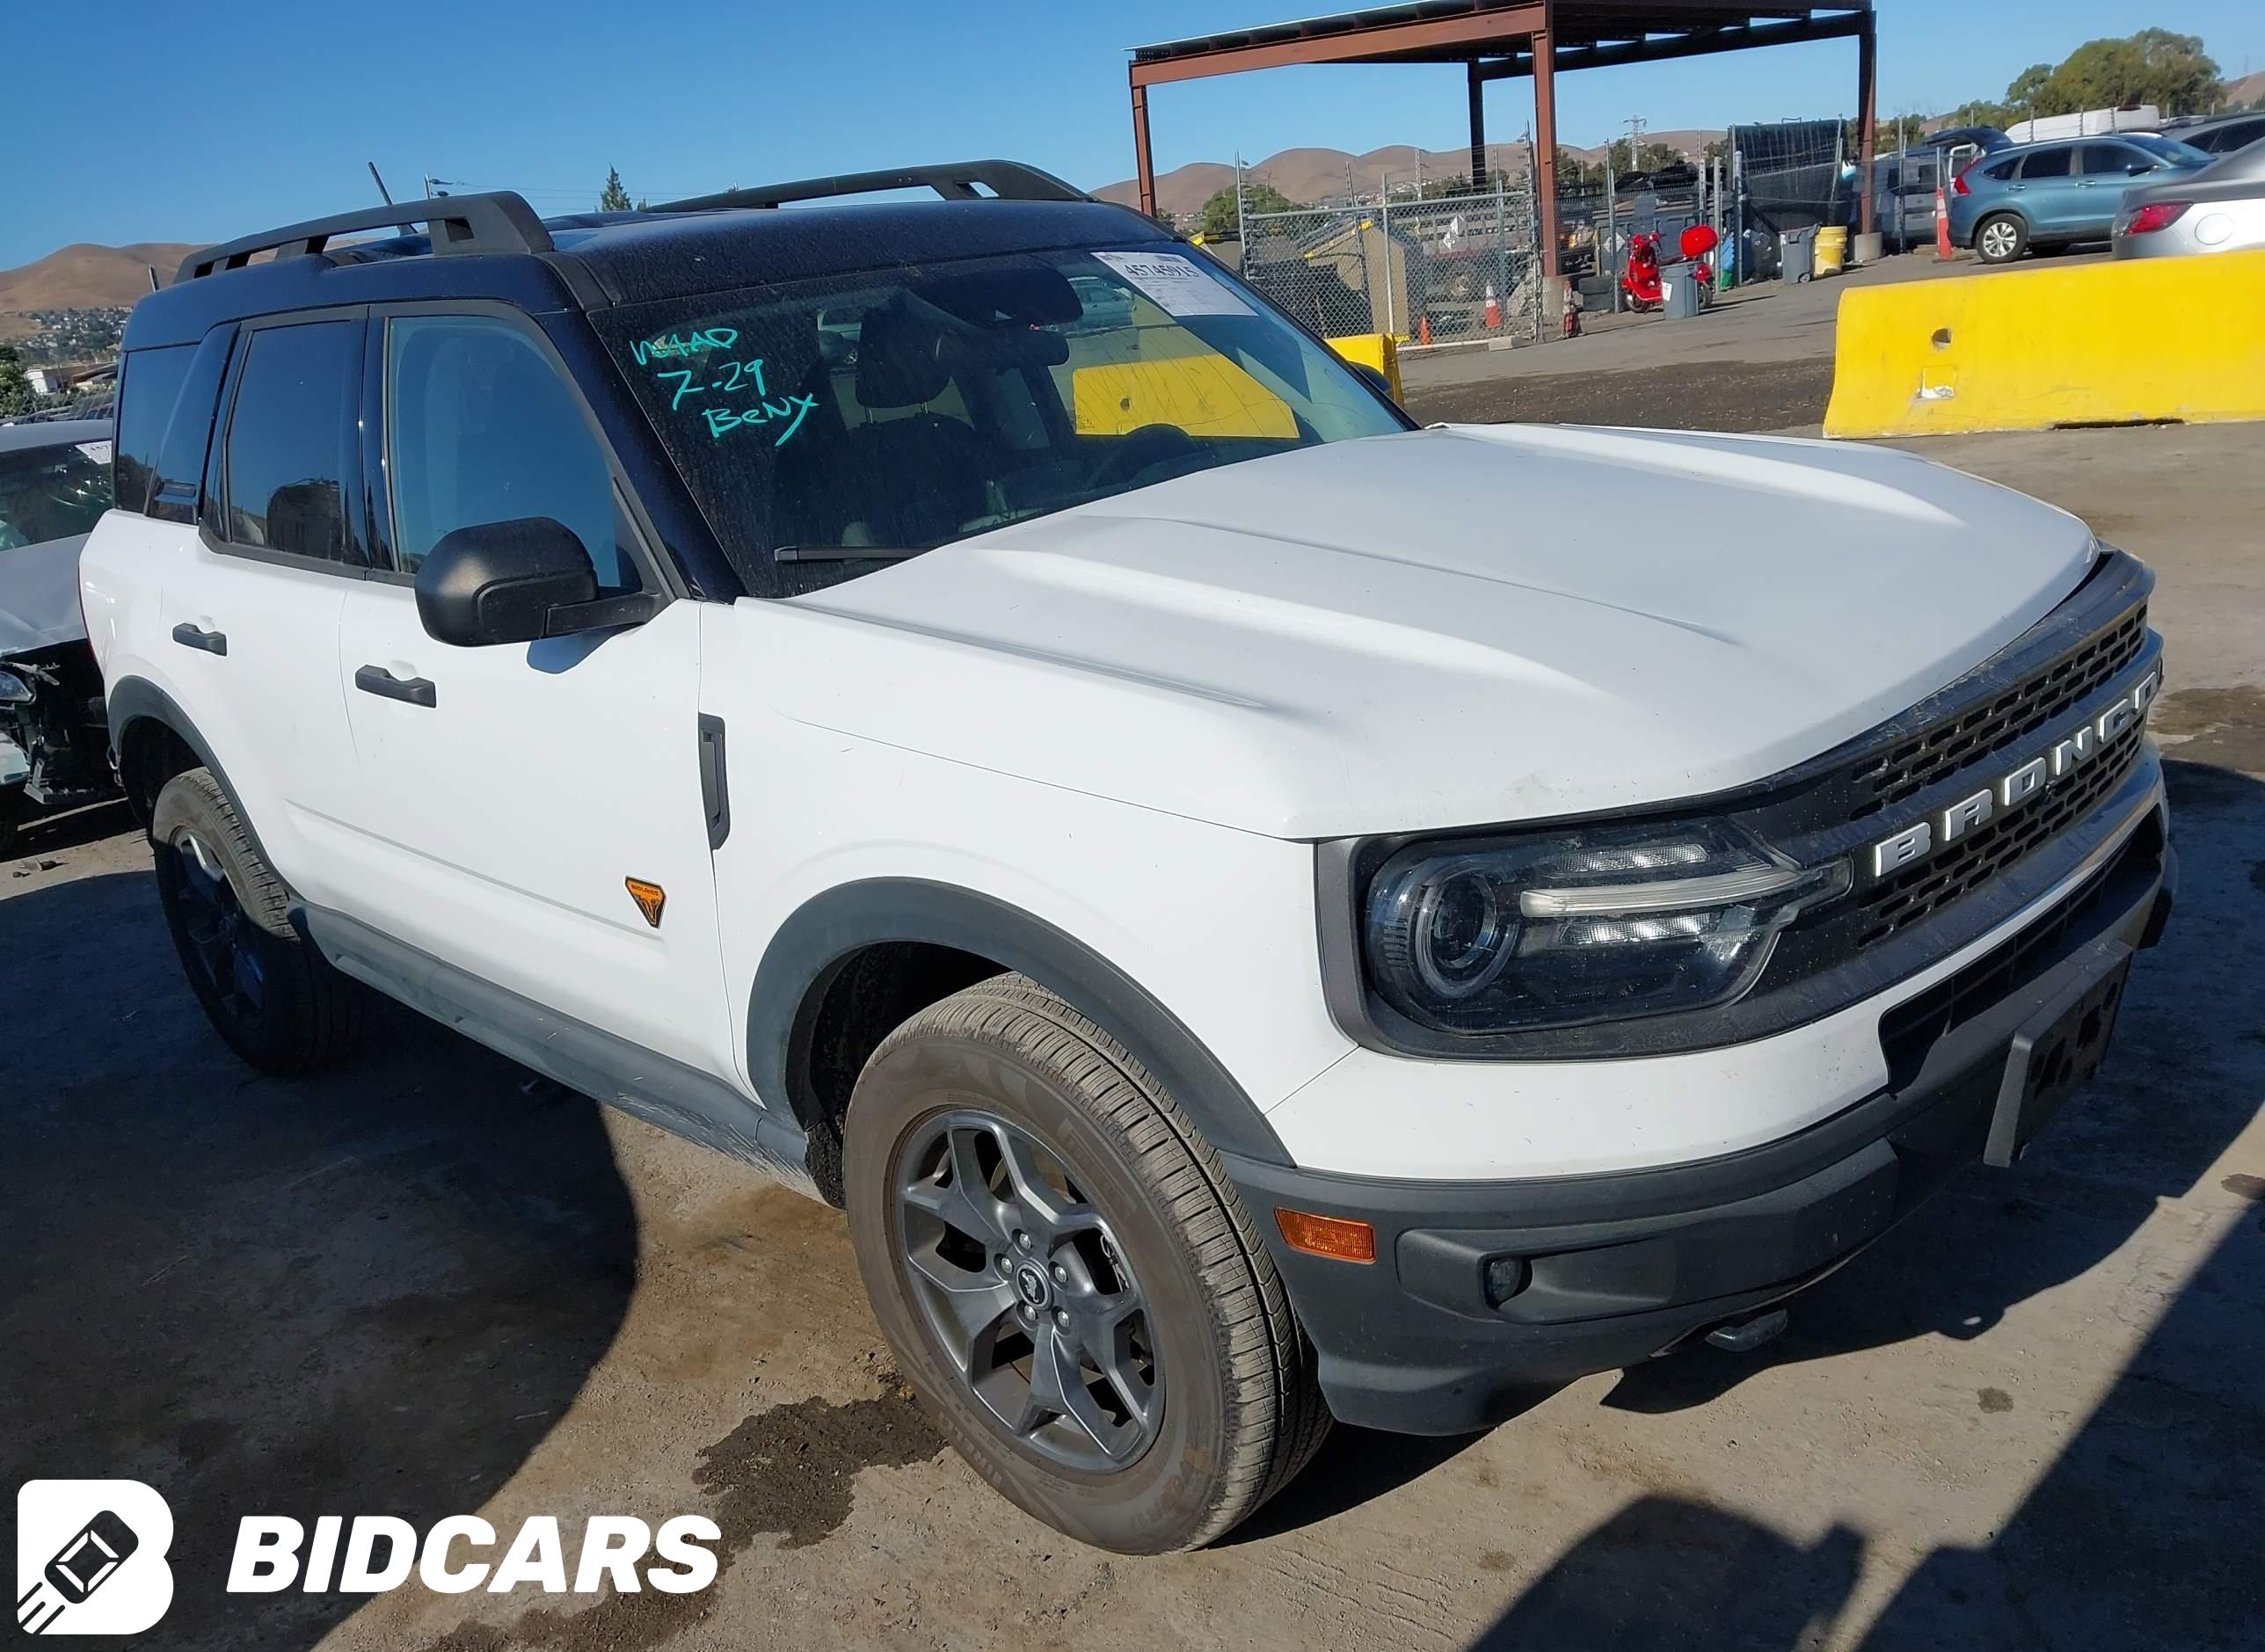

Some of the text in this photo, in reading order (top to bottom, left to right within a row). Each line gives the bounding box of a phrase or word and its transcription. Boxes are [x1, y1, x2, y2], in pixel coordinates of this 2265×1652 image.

[1125, 264, 1200, 278] 45745915
[657, 358, 766, 411] 7-29
[1874, 670, 2159, 878] BRONCO
